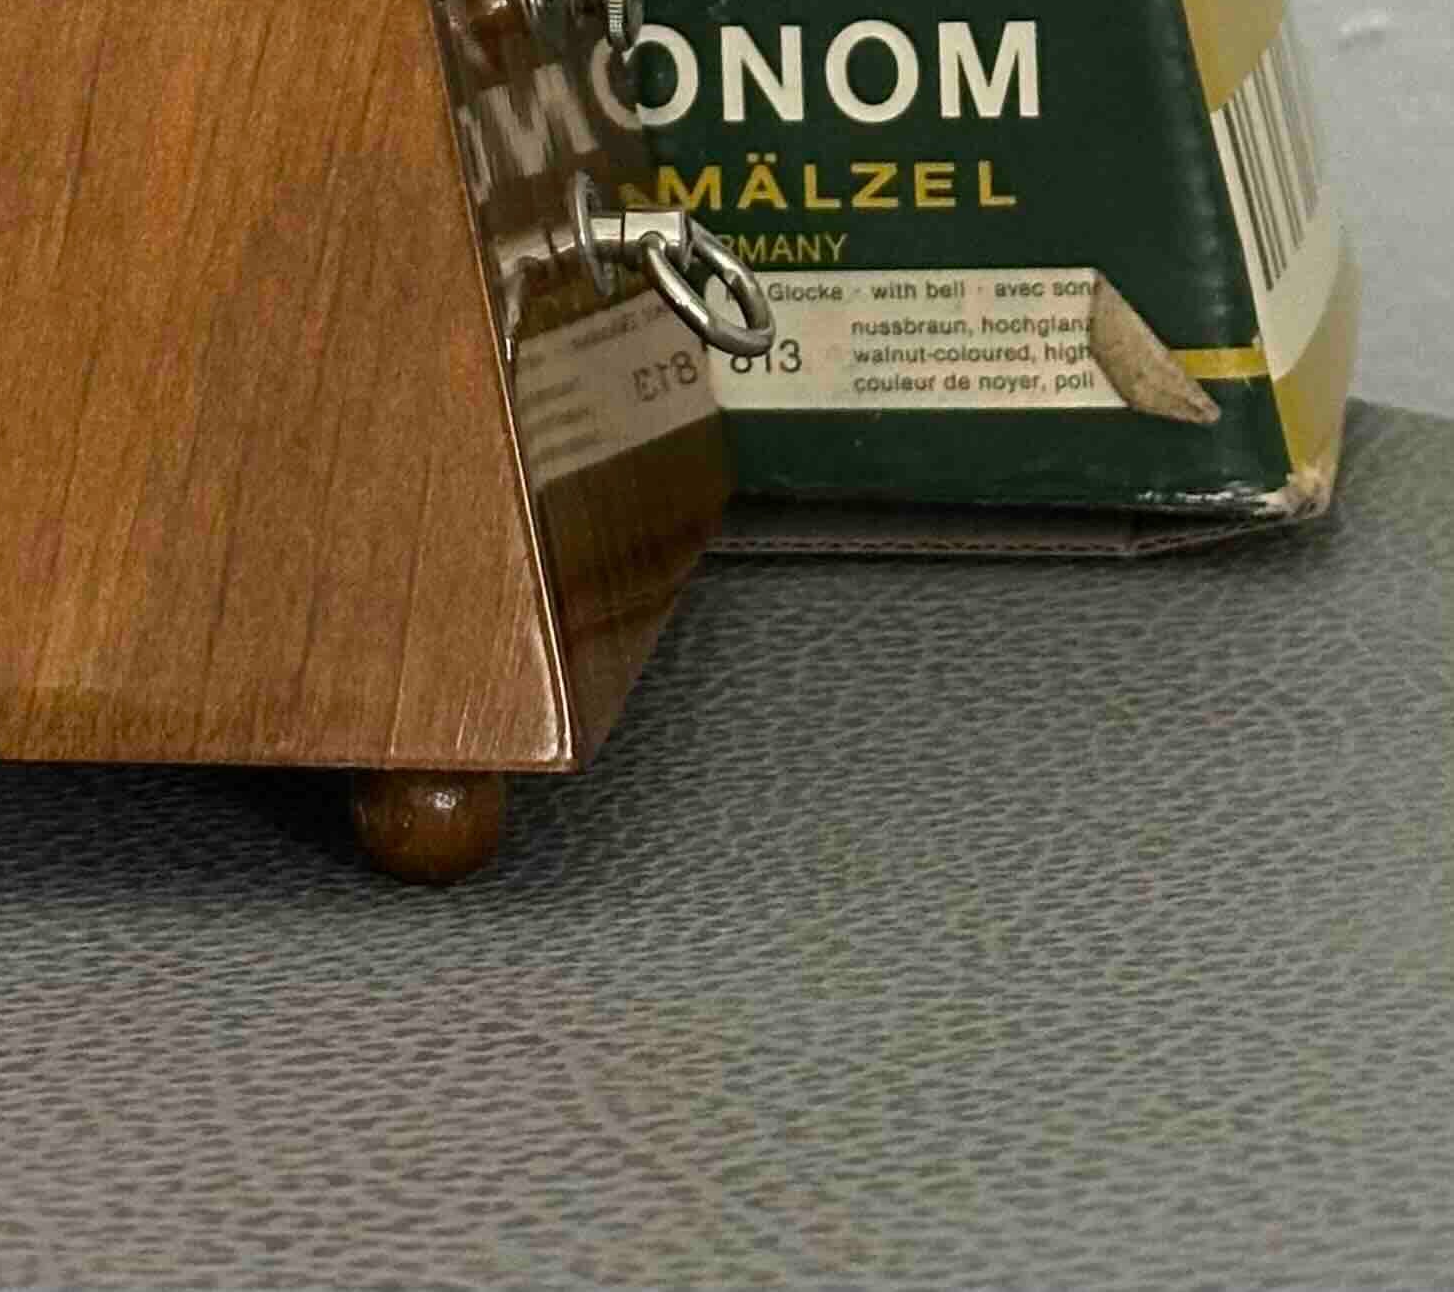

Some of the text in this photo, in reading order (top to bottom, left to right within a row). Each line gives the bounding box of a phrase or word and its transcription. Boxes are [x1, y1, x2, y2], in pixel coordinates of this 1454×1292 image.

[592, 20, 1041, 126] ONOM
[768, 282, 843, 302] Glocke
[871, 282, 917, 299] with
[926, 281, 964, 299] bell
[995, 282, 1044, 297] avec
[854, 374, 936, 393] couleur
[943, 373, 970, 390] de
